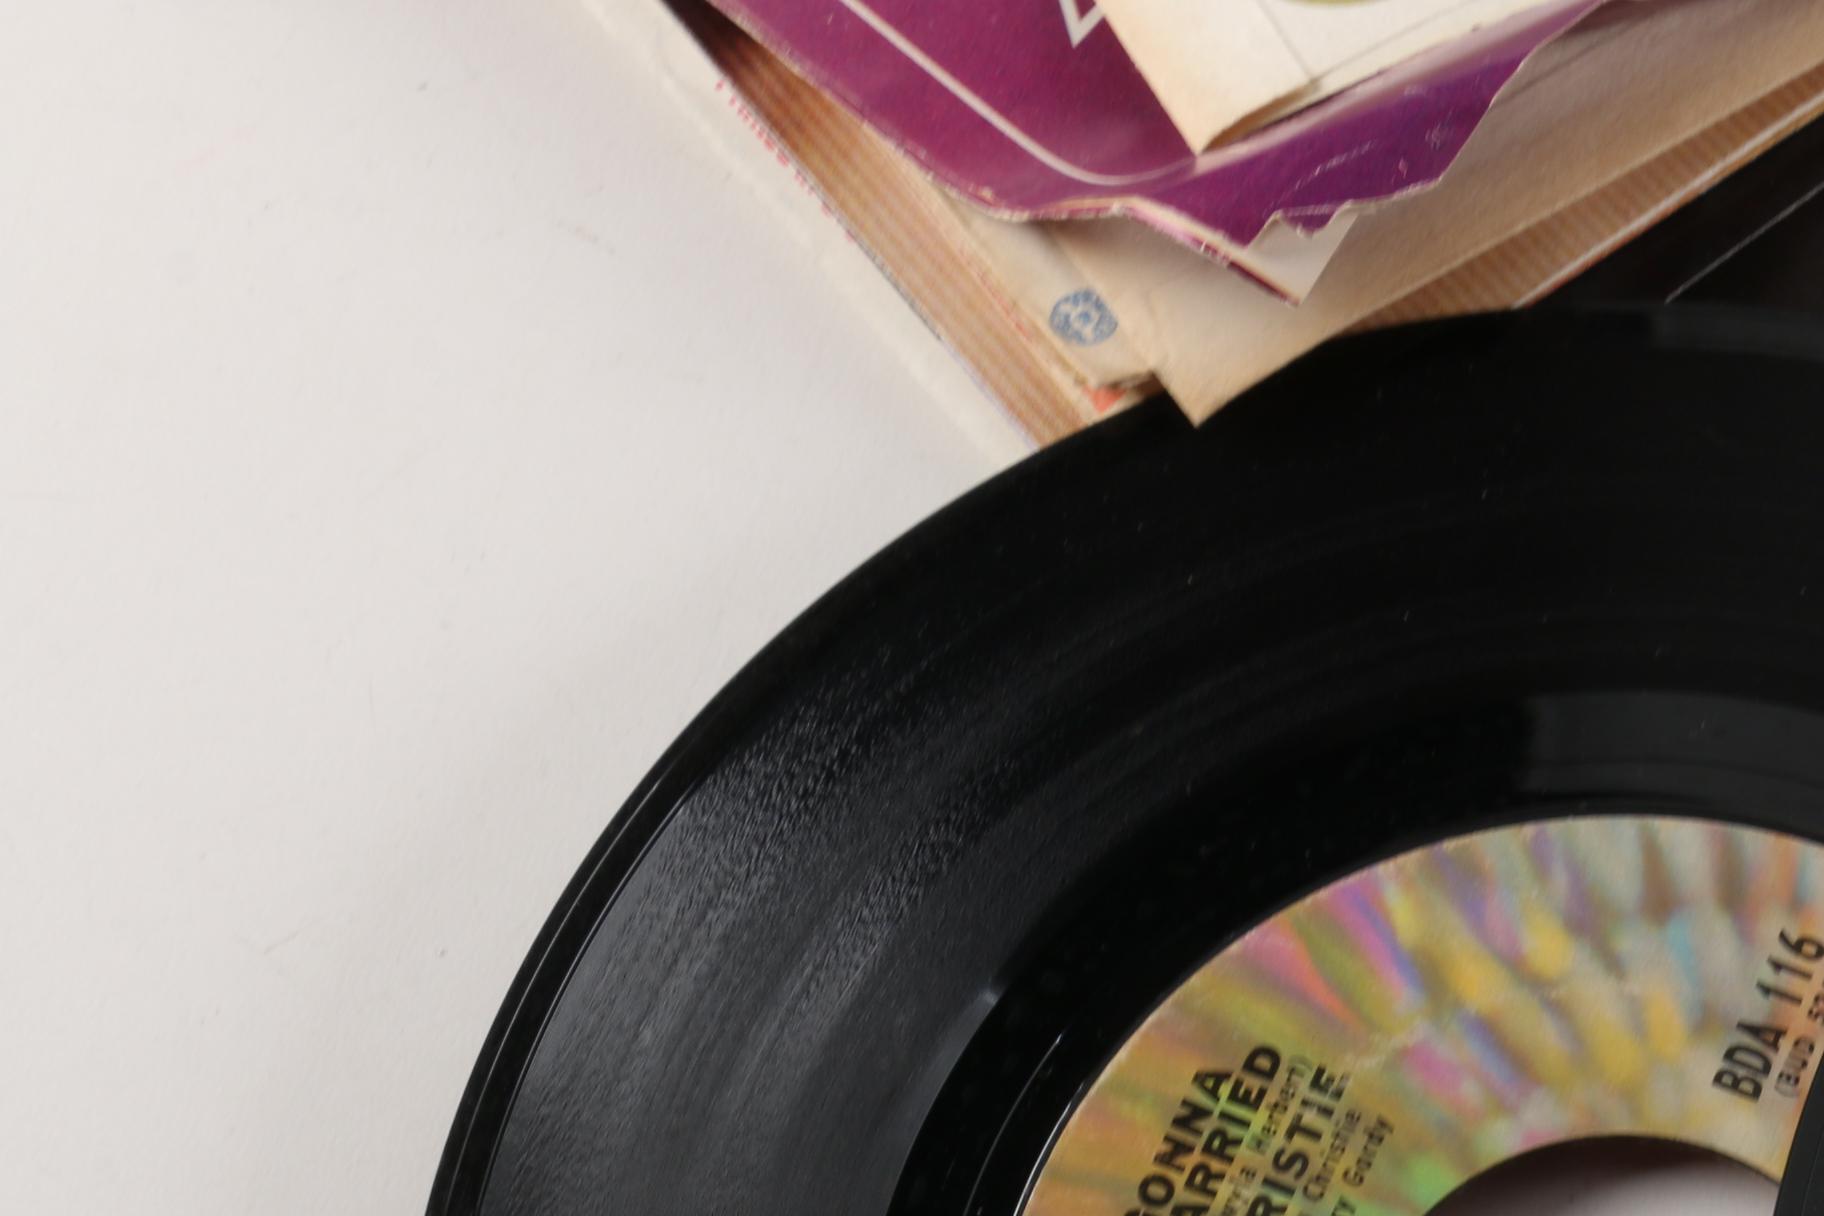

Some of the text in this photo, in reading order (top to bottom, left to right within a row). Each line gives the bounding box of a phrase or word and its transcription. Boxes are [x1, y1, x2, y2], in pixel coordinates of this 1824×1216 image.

[1712, 1021, 1789, 1104] BDA
[1303, 1109, 1361, 1202] Christie
[1342, 1114, 1394, 1186] Gordy
